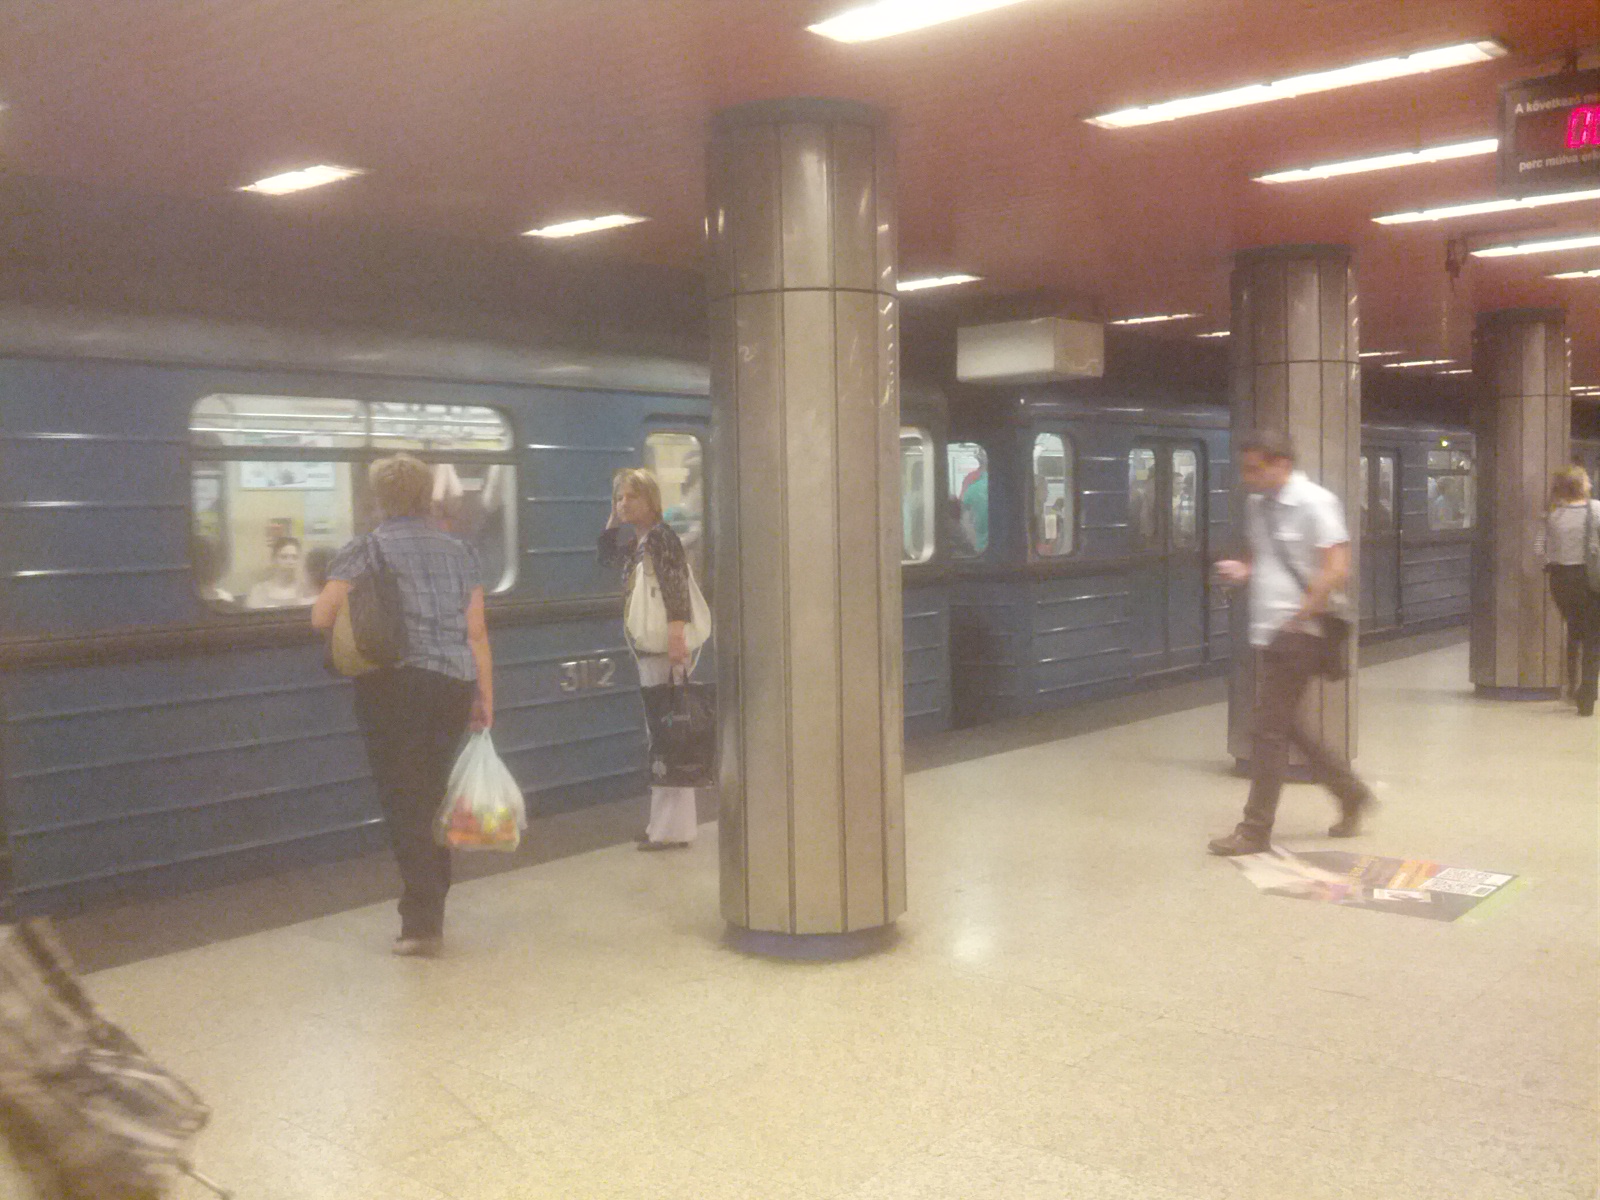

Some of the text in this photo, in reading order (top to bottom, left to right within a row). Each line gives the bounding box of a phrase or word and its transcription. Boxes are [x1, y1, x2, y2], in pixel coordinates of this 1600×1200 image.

[1515, 103, 1524, 114] A
[1519, 160, 1543, 173] perc
[560, 657, 616, 692] 312
